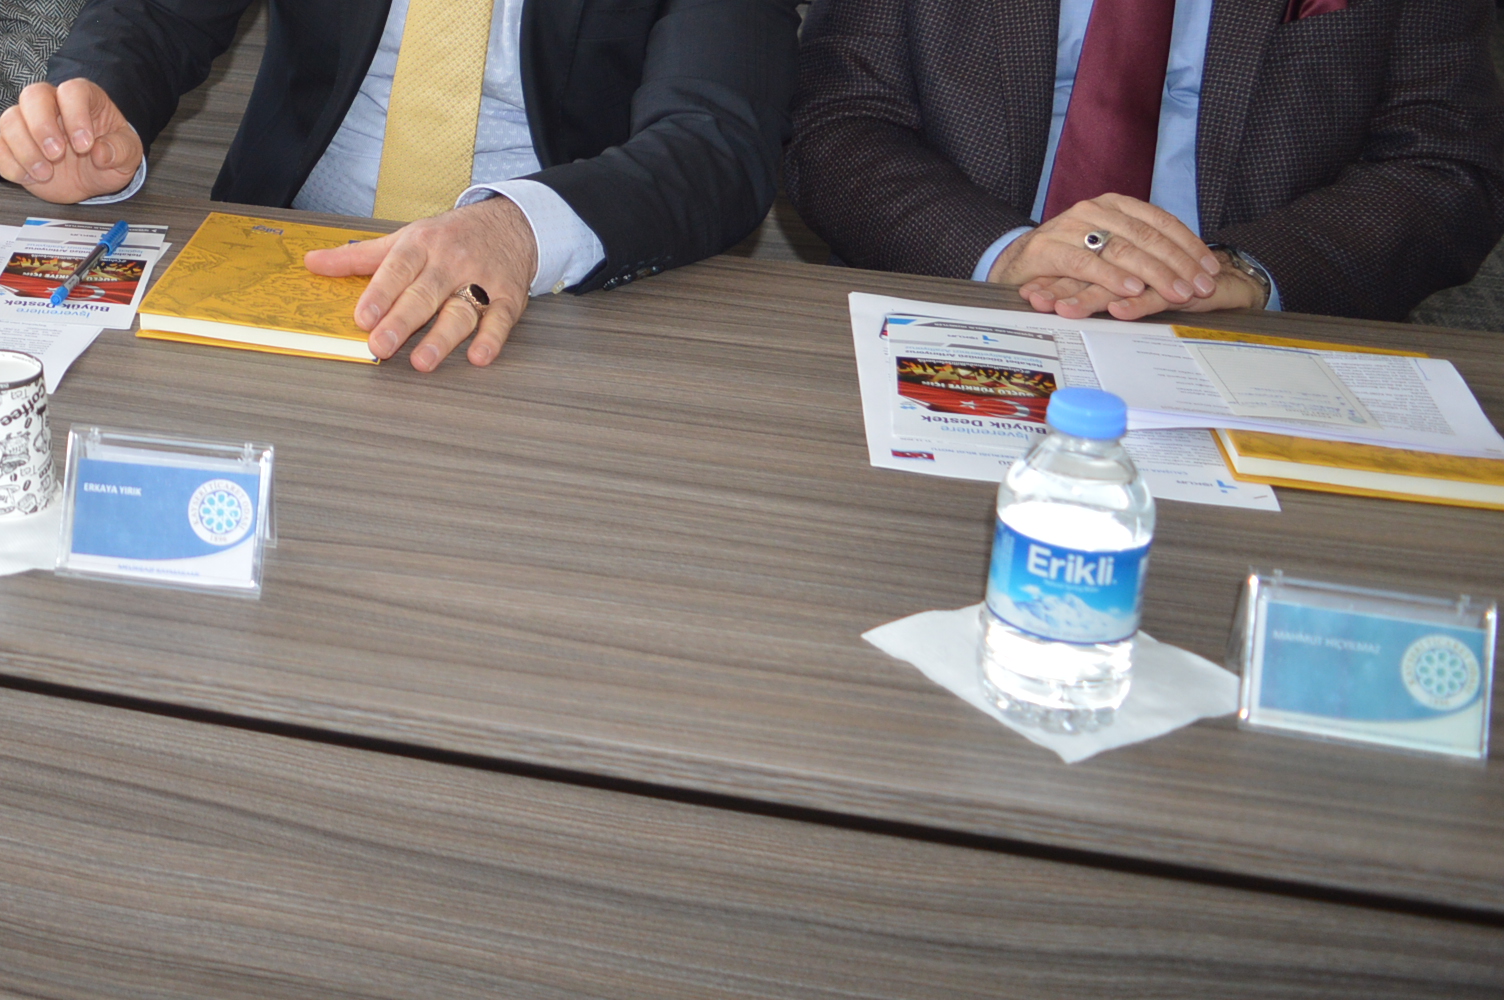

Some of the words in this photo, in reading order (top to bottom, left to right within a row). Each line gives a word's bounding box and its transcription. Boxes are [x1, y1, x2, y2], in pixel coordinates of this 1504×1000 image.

[16, 307, 91, 318] İşverenlere
[62, 303, 110, 313] Büyük
[10, 389, 30, 400] Tea
[948, 383, 995, 394] TÜRKİYE
[0, 383, 45, 426] Coffee
[921, 414, 983, 427] Destek
[940, 425, 1030, 441] İşverenlere
[990, 421, 1048, 435] Büyük
[83, 482, 118, 494] ERKAYA
[119, 486, 142, 497] YIRIK
[1026, 543, 1115, 586] Erikli
